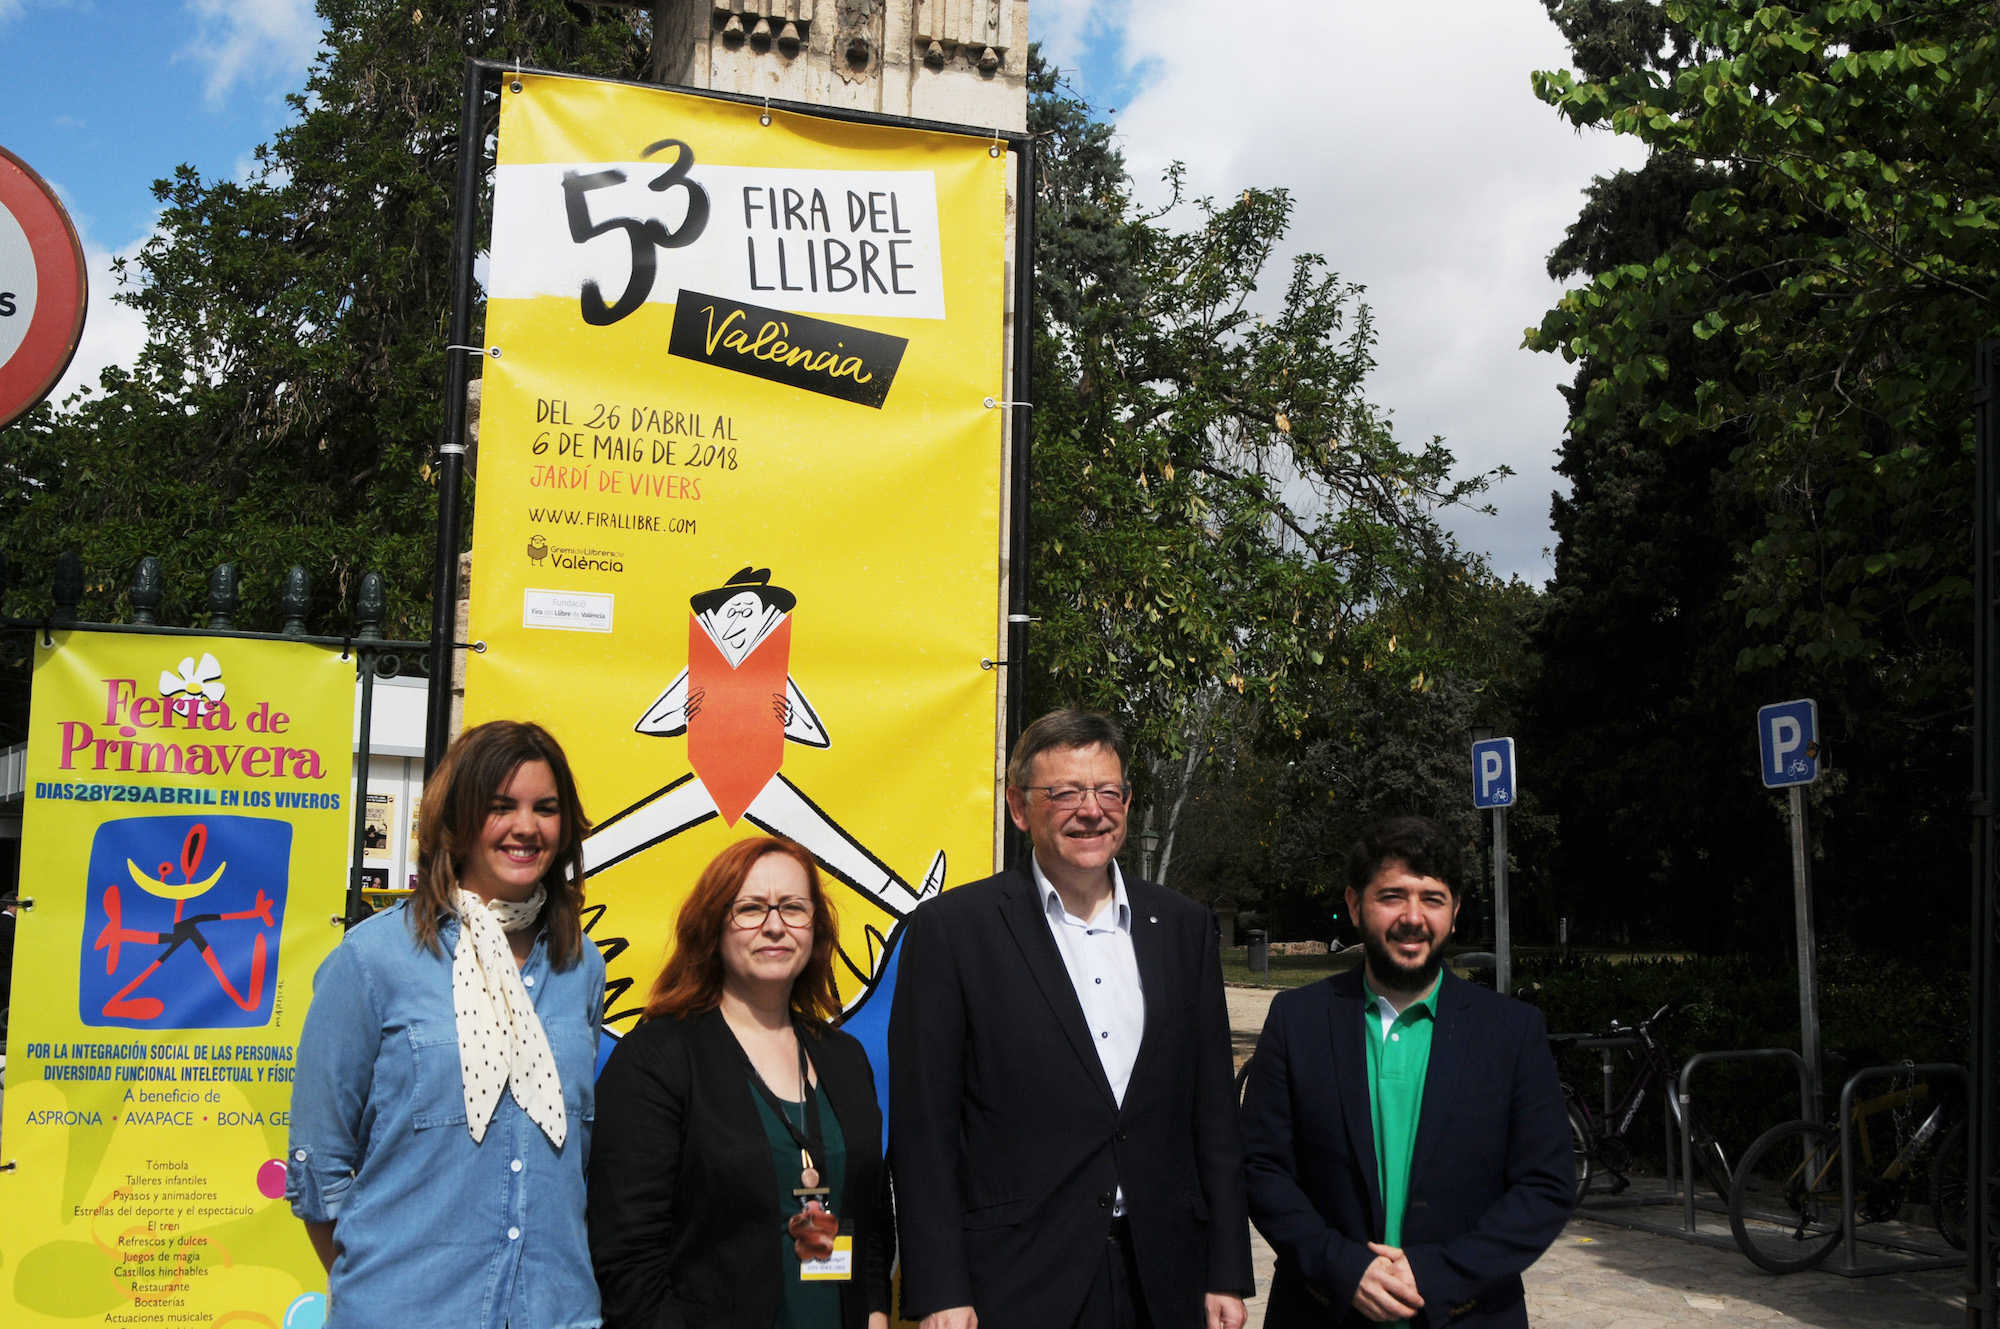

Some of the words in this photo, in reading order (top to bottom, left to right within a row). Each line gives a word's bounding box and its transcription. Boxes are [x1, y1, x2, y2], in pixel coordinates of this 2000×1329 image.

[562, 138, 710, 326] 53
[743, 186, 831, 233] FIRA
[847, 190, 912, 234] DEL
[747, 236, 917, 295] LLIBRE
[700, 305, 872, 384] València
[536, 398, 573, 425] DEL
[583, 403, 621, 430] 26
[632, 406, 705, 440] D'ABRIL
[712, 416, 738, 441] AL
[532, 432, 550, 455] 6
[559, 432, 584, 457] DE
[594, 435, 643, 463] MAIG
[652, 440, 677, 466] DE
[685, 443, 738, 471] 2018
[530, 464, 591, 490] JARDÍ
[599, 470, 624, 493] DE
[630, 472, 701, 500] VIVERS
[529, 508, 697, 535] WWW.FIRALLIBRE.COM
[551, 554, 623, 572] València
[101, 679, 236, 731] Feria
[246, 702, 290, 733] de
[57, 721, 327, 780] Primavera
[1770, 716, 1801, 774] P
[1481, 751, 1502, 797] P
[220, 790, 238, 807] EN
[243, 791, 270, 808] LOS
[275, 792, 340, 809] VIVEROS
[27, 1043, 50, 1059] POR
[54, 1044, 67, 1059] LA
[72, 1040, 147, 1060] INTEGRACIÓN
[150, 1045, 190, 1060] SOCIAL
[194, 1045, 208, 1060] DE
[212, 1045, 232, 1060] LAS
[235, 1045, 293, 1061] PERSONAS
[44, 1065, 111, 1081] DIVERSIDAD
[114, 1066, 177, 1081] FUNCIONAL
[181, 1066, 253, 1082] INTELECTUAL
[256, 1067, 264, 1082] Y
[123, 1089, 135, 1103] A
[139, 1088, 200, 1103] beneficio
[204, 1089, 221, 1103] de
[26, 1110, 102, 1125] ASPRONA
[125, 1111, 193, 1126] AVAPACE
[217, 1111, 266, 1126] BONA
[146, 1160, 189, 1170] Tómbola
[126, 1175, 162, 1185] Talleres
[165, 1175, 207, 1185] infantiles
[113, 1190, 150, 1201] Payasos
[153, 1192, 159, 1201] y
[162, 1191, 217, 1201] animadores
[74, 1206, 114, 1216] Estrellas
[117, 1206, 132, 1216] del
[135, 1206, 174, 1218] deporte
[177, 1208, 183, 1218] y
[186, 1206, 195, 1216] el
[198, 1206, 254, 1217] espectáculo
[148, 1221, 156, 1231] El
[160, 1222, 180, 1231] tren
[118, 1236, 165, 1246] Refrescos
[169, 1238, 174, 1247] y
[177, 1236, 208, 1246] dulces
[123, 1251, 154, 1264] Juegos
[158, 1251, 169, 1261] de
[173, 1252, 200, 1264] magia
[114, 1266, 155, 1277] Castillos
[158, 1266, 208, 1277] hinchables
[131, 1282, 190, 1292] Restaurante
[105, 1313, 164, 1323] Actuaciones
[167, 1311, 213, 1322] musicales
